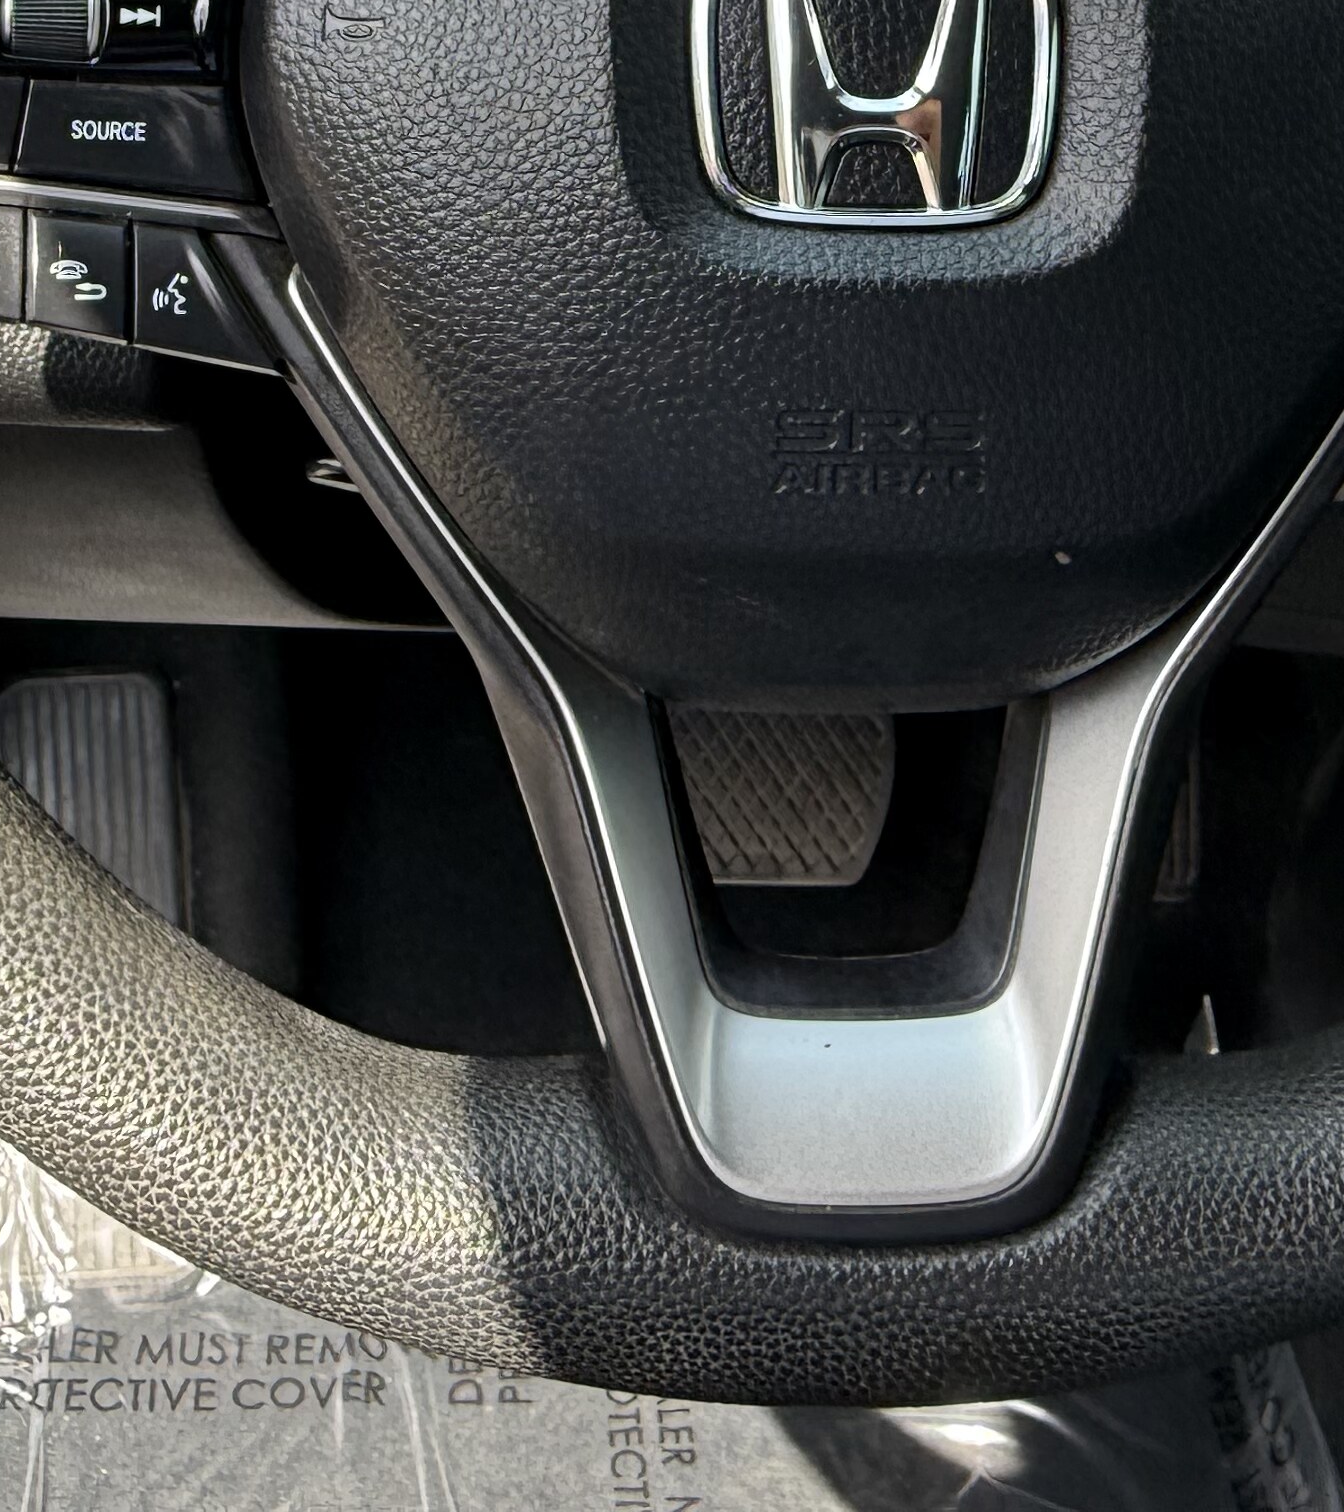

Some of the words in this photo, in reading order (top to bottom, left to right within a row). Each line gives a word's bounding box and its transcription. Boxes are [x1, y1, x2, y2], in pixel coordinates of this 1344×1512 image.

[70, 119, 147, 142] SOURCE
[774, 409, 986, 453] SRS
[38, 1326, 120, 1365] LER
[135, 1332, 248, 1366] MUST
[265, 1332, 390, 1366] REMO
[231, 1369, 387, 1412] COVER
[656, 1398, 698, 1467] LER
